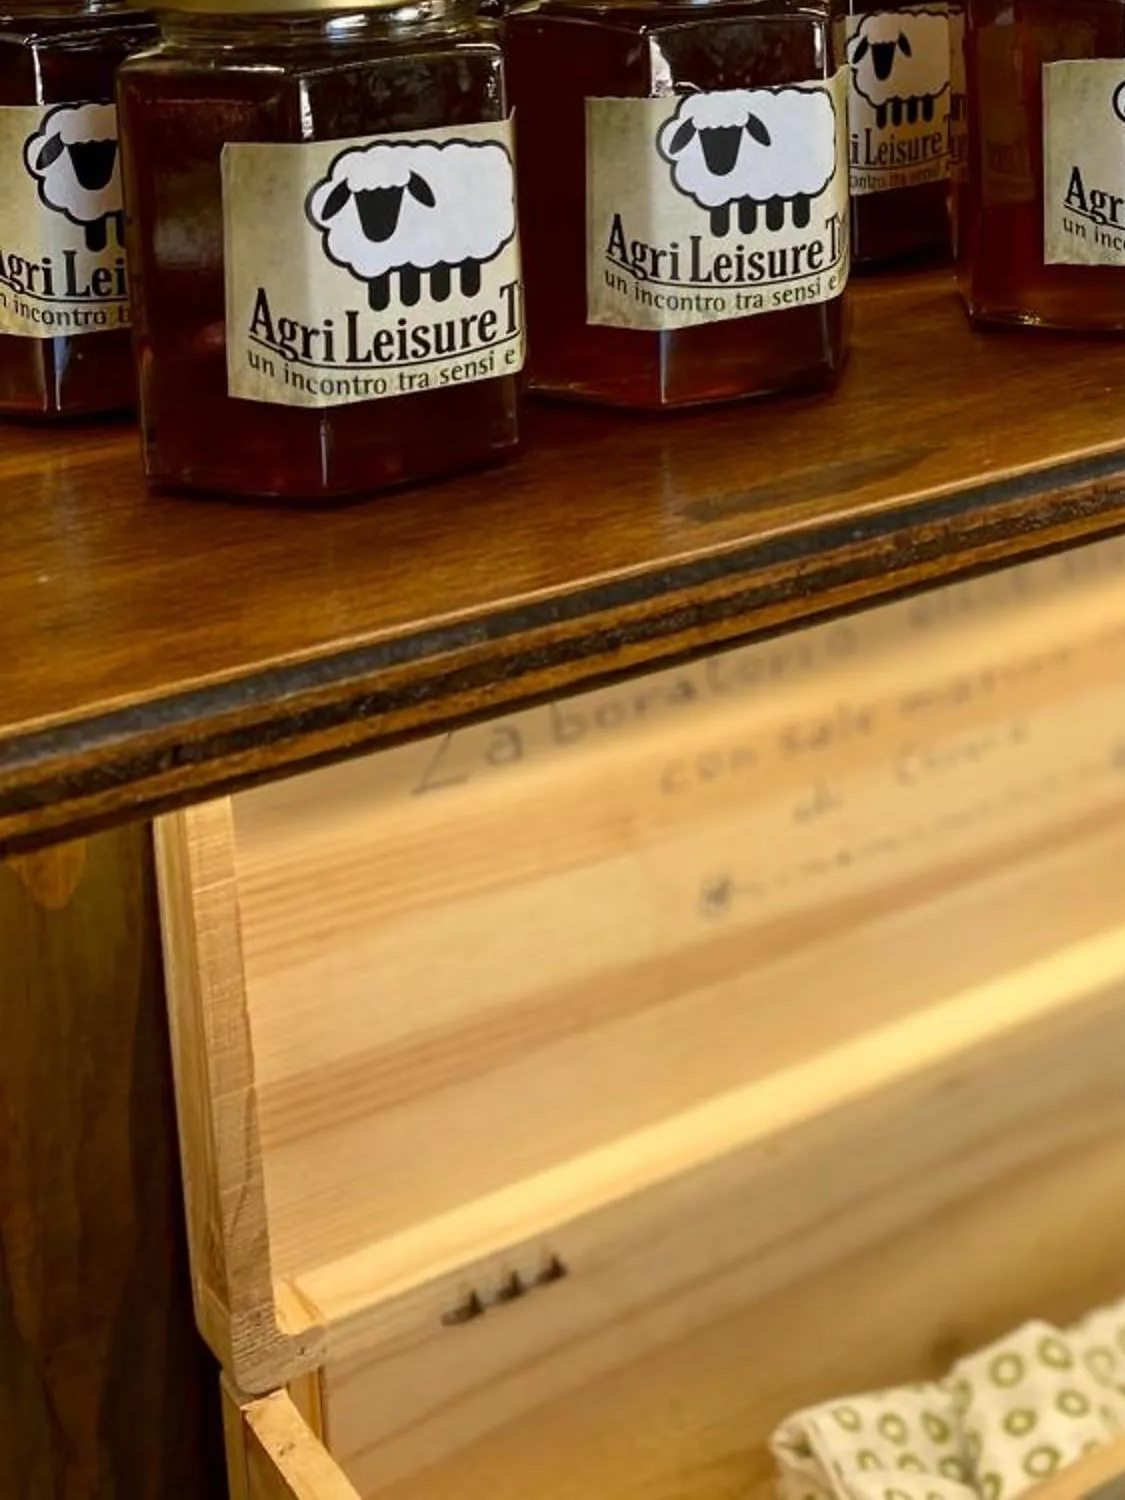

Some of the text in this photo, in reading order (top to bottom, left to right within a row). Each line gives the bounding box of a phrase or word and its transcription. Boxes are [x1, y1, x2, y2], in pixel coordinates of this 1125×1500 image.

[605, 213, 681, 282] Agri
[689, 235, 823, 284] Leisure
[1062, 217, 1087, 239] un
[13, 293, 108, 327] incontro
[604, 269, 628, 295] un
[634, 281, 725, 312] incontro
[735, 291, 764, 311] tra
[771, 276, 821, 307] sensi
[249, 287, 336, 363] Agri
[345, 310, 498, 363] Leisure
[247, 348, 516, 397] un incontro tra sensi e
